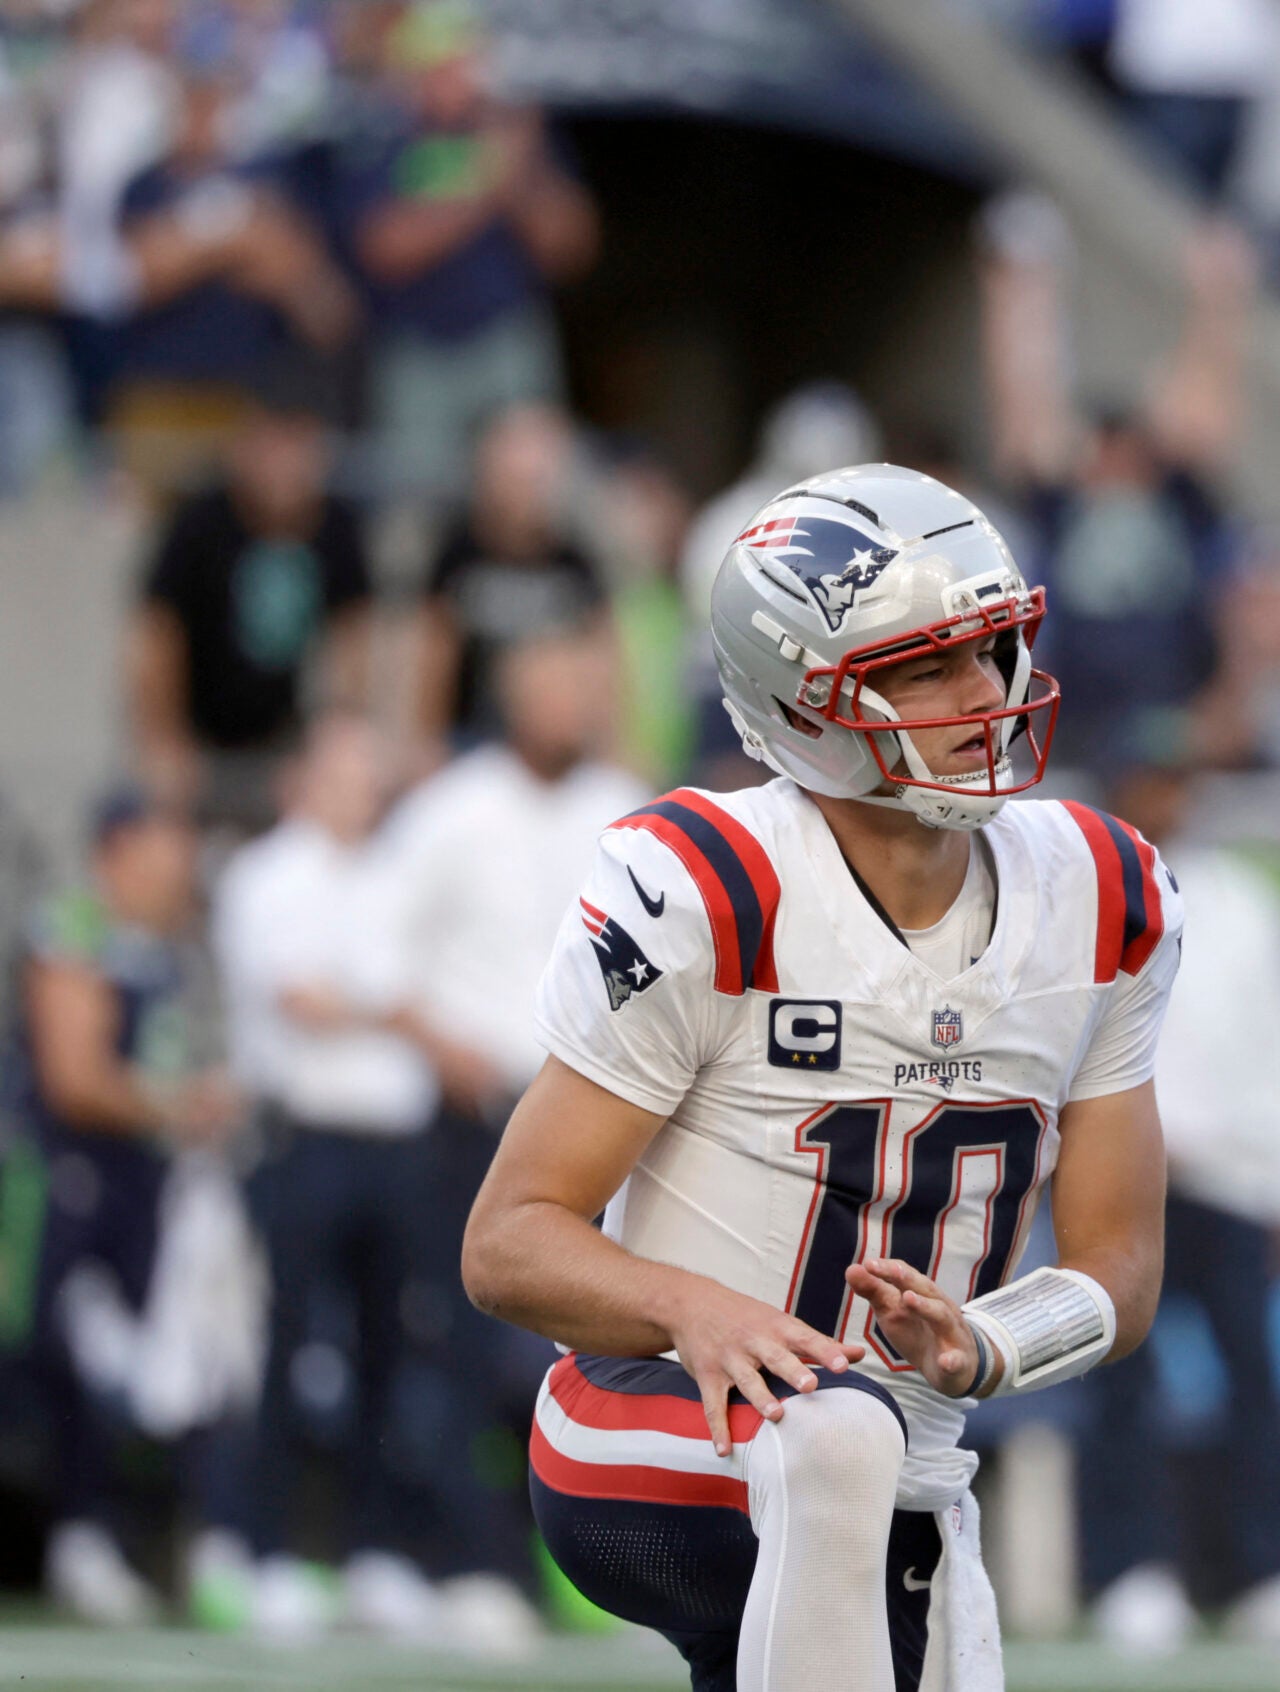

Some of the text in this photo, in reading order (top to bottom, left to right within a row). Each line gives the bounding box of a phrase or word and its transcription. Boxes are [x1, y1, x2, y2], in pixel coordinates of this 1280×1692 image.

[774, 1004, 837, 1053] C
[936, 1025, 959, 1043] NFL
[894, 1061, 982, 1087] PATRIOTS
[784, 1097, 1048, 1372] 10
